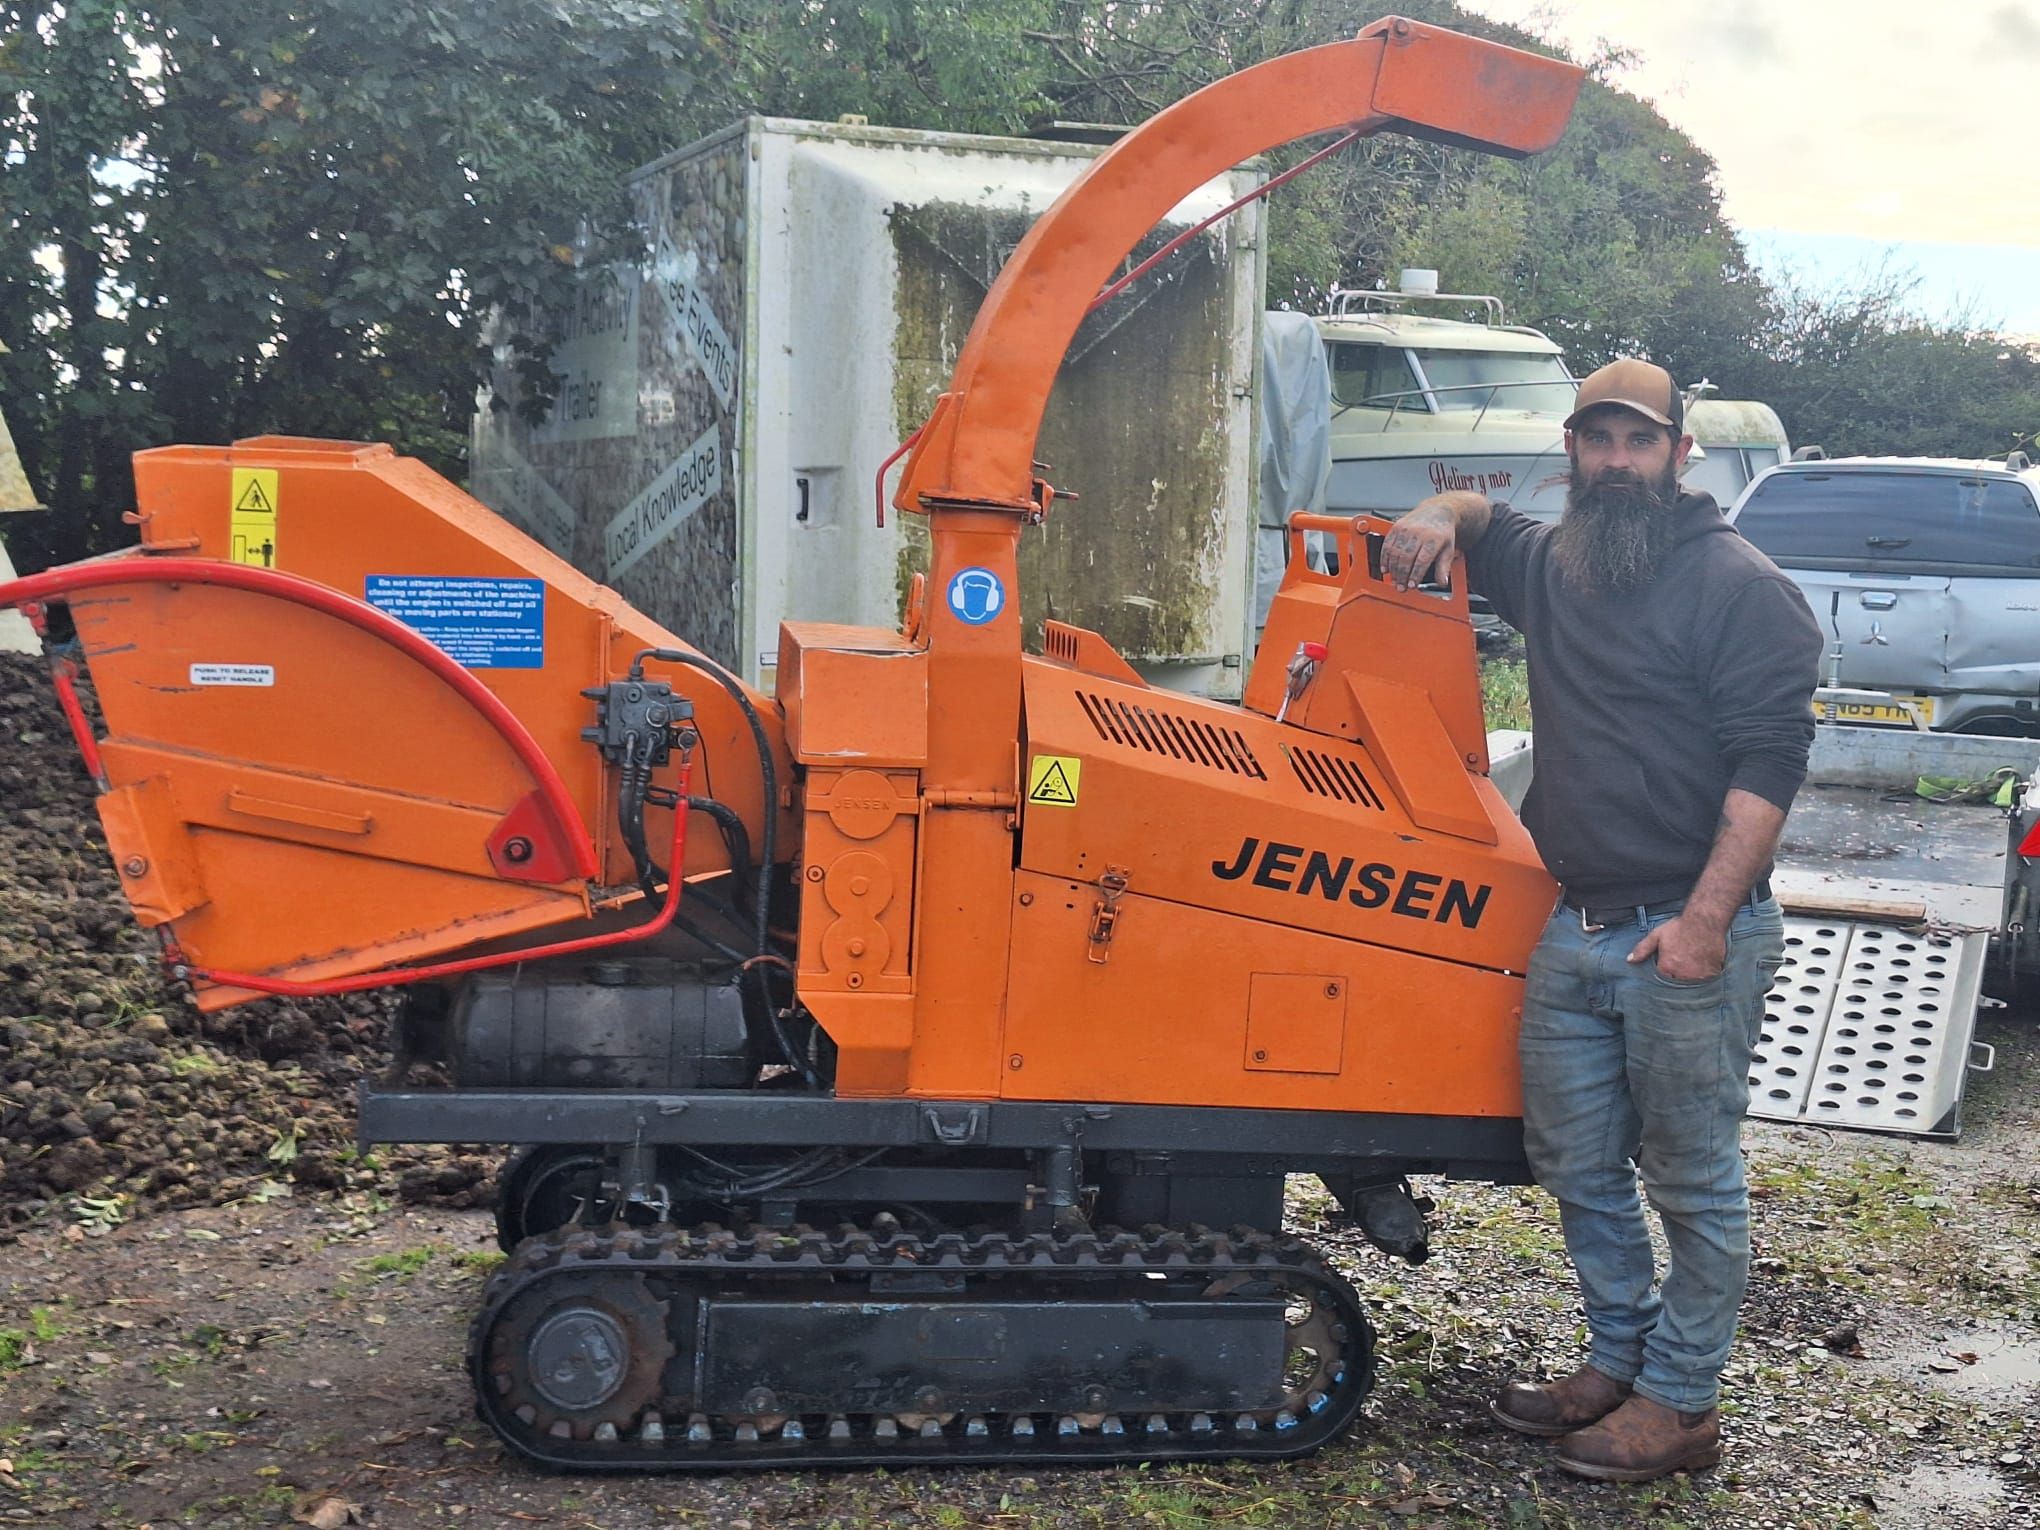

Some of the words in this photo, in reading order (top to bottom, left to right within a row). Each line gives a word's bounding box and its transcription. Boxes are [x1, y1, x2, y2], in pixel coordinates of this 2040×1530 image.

[687, 290, 732, 393] Events
[1477, 474, 1487, 496] y
[607, 506, 640, 568] Local
[641, 445, 716, 535] Knowledge
[409, 580, 444, 589] attempt
[445, 581, 498, 590] inspections,
[499, 582, 532, 590] repairs,
[368, 588, 406, 598] cleaning
[418, 589, 472, 598] adjustments
[485, 590, 500, 598] the
[501, 591, 541, 599] machines
[373, 598, 394, 606] until
[412, 599, 442, 608] engine
[453, 599, 492, 607] switched
[493, 600, 506, 608] off
[508, 600, 524, 608] and
[525, 600, 536, 608] all
[388, 608, 403, 616] the
[404, 608, 436, 618] moving
[437, 609, 461, 618] parts
[478, 609, 522, 619] stationary
[834, 798, 890, 810] JENSEN
[1211, 836, 1493, 929] JENSEN
